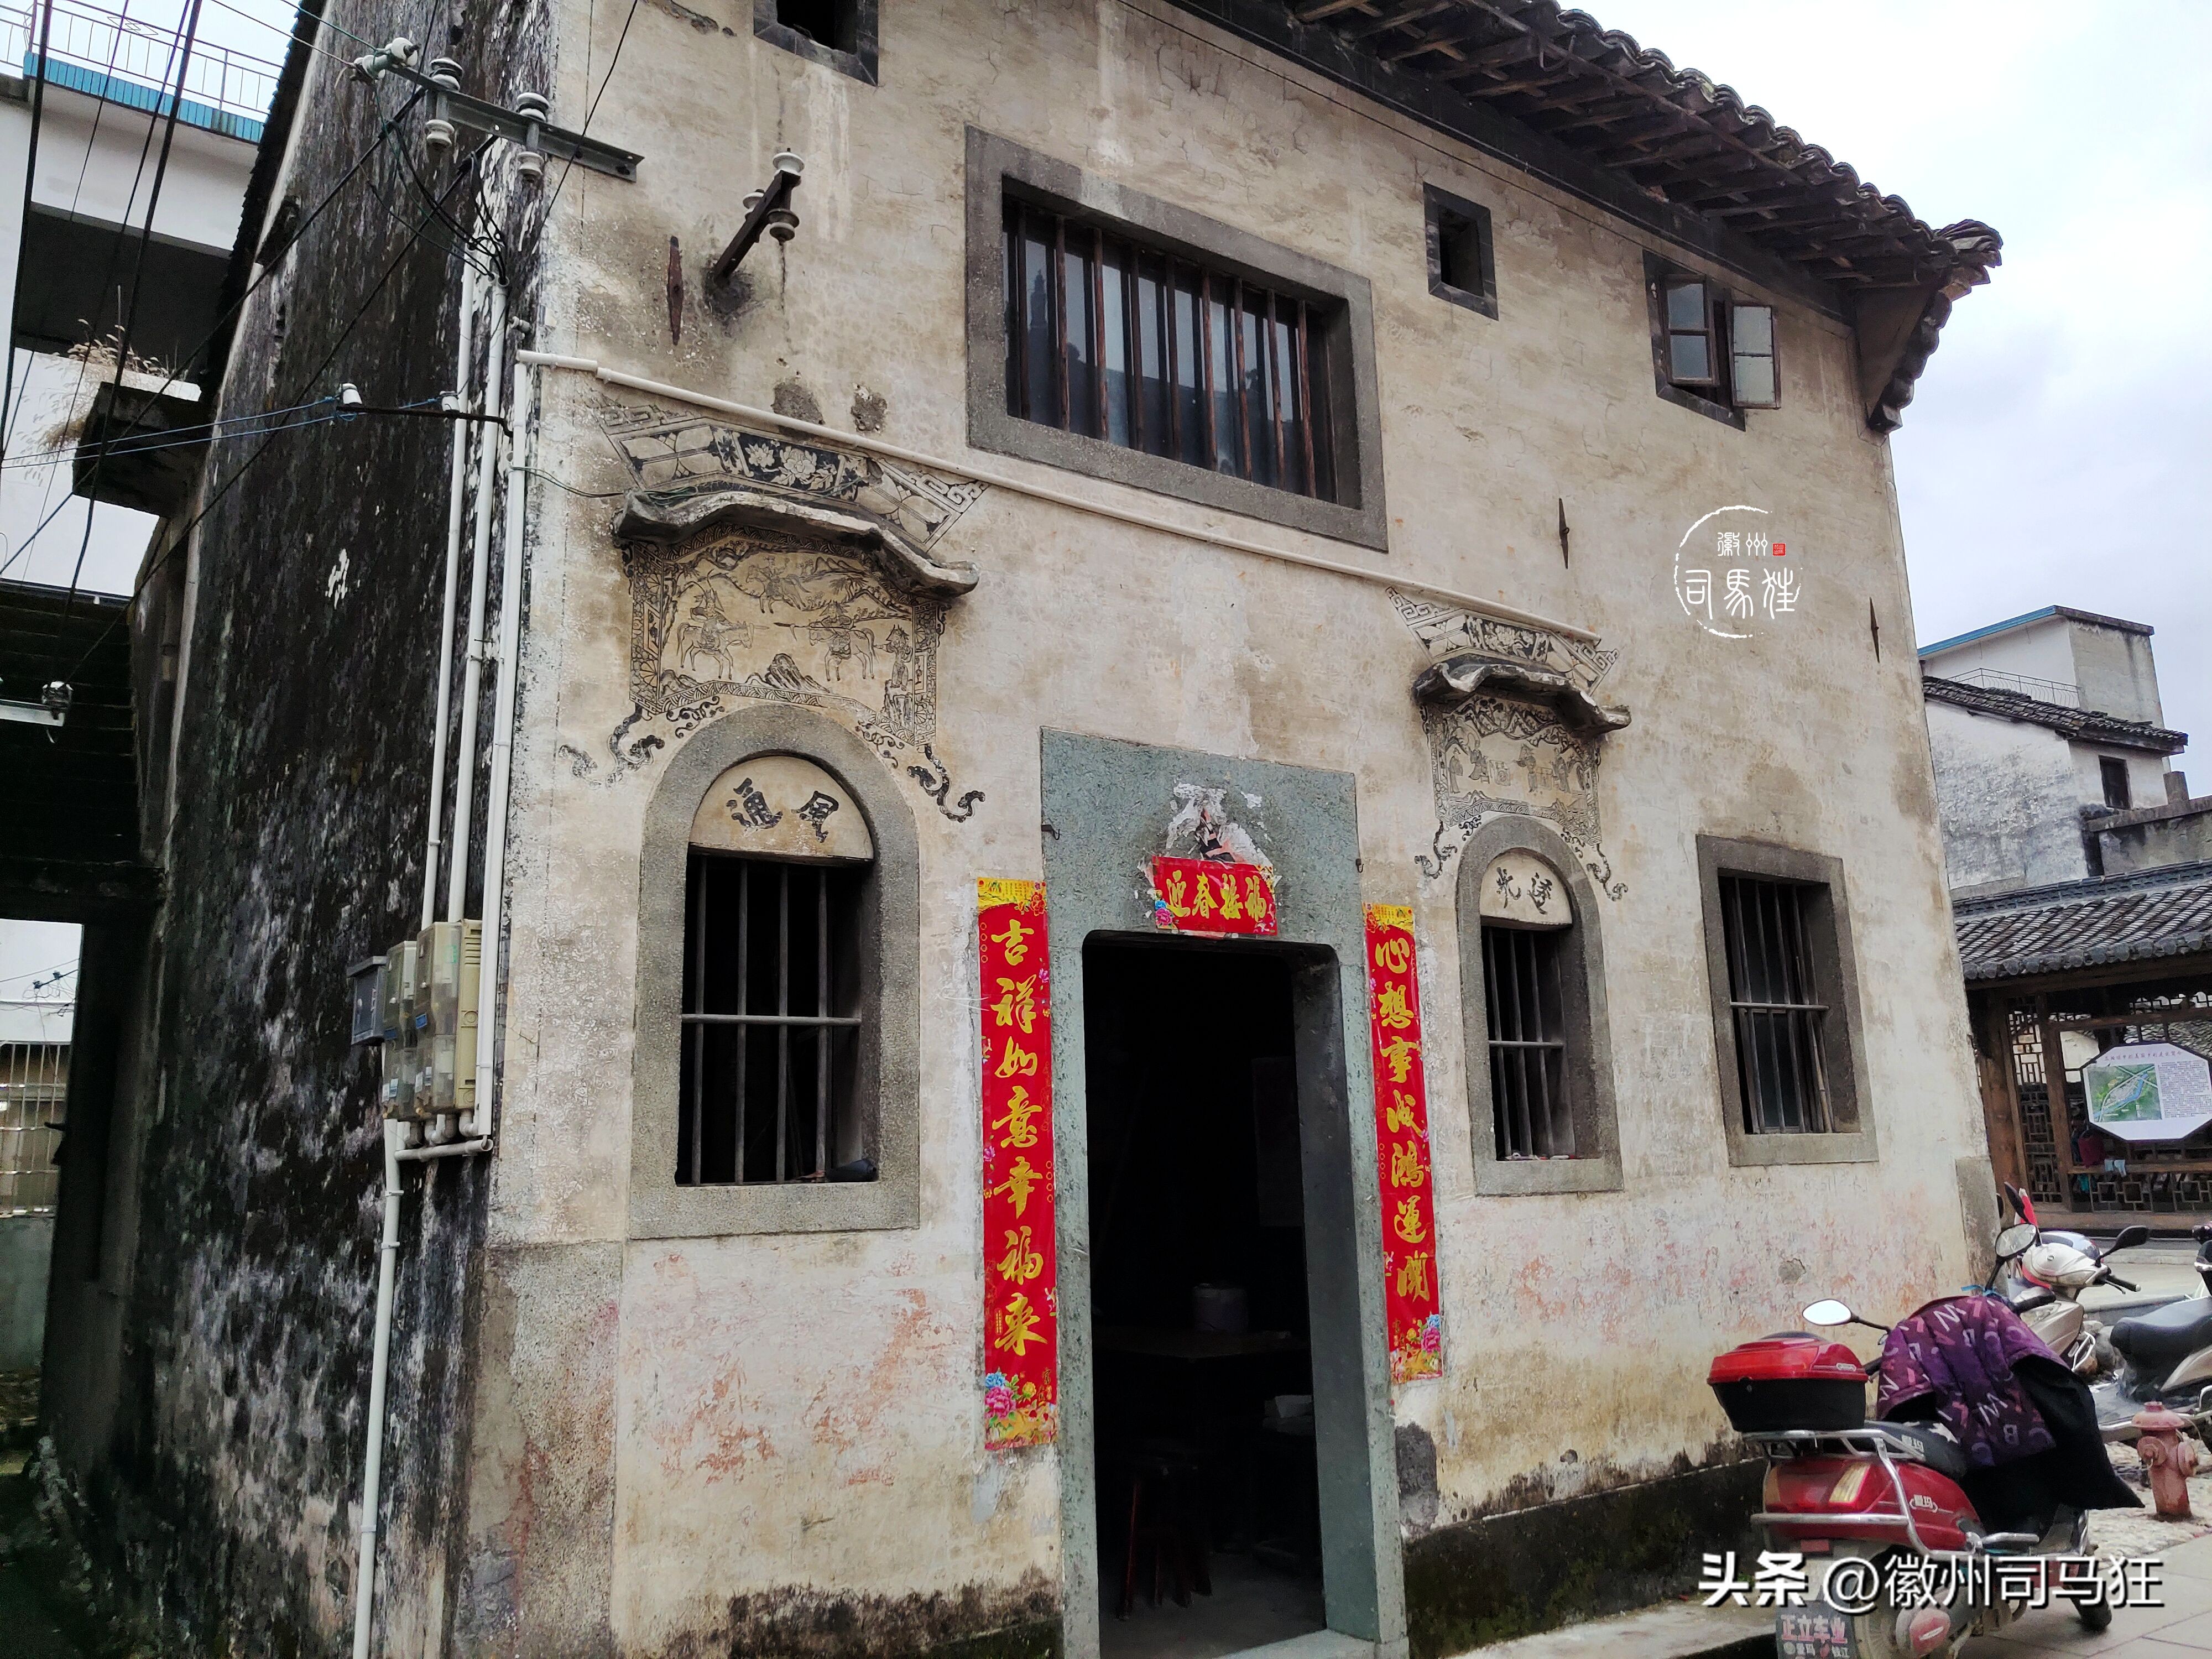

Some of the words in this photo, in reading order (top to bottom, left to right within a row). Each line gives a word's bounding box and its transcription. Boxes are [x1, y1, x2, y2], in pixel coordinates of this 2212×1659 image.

[1166, 869, 1267, 922] 迎春接福
[1780, 1614, 1848, 1644] 正立车业
